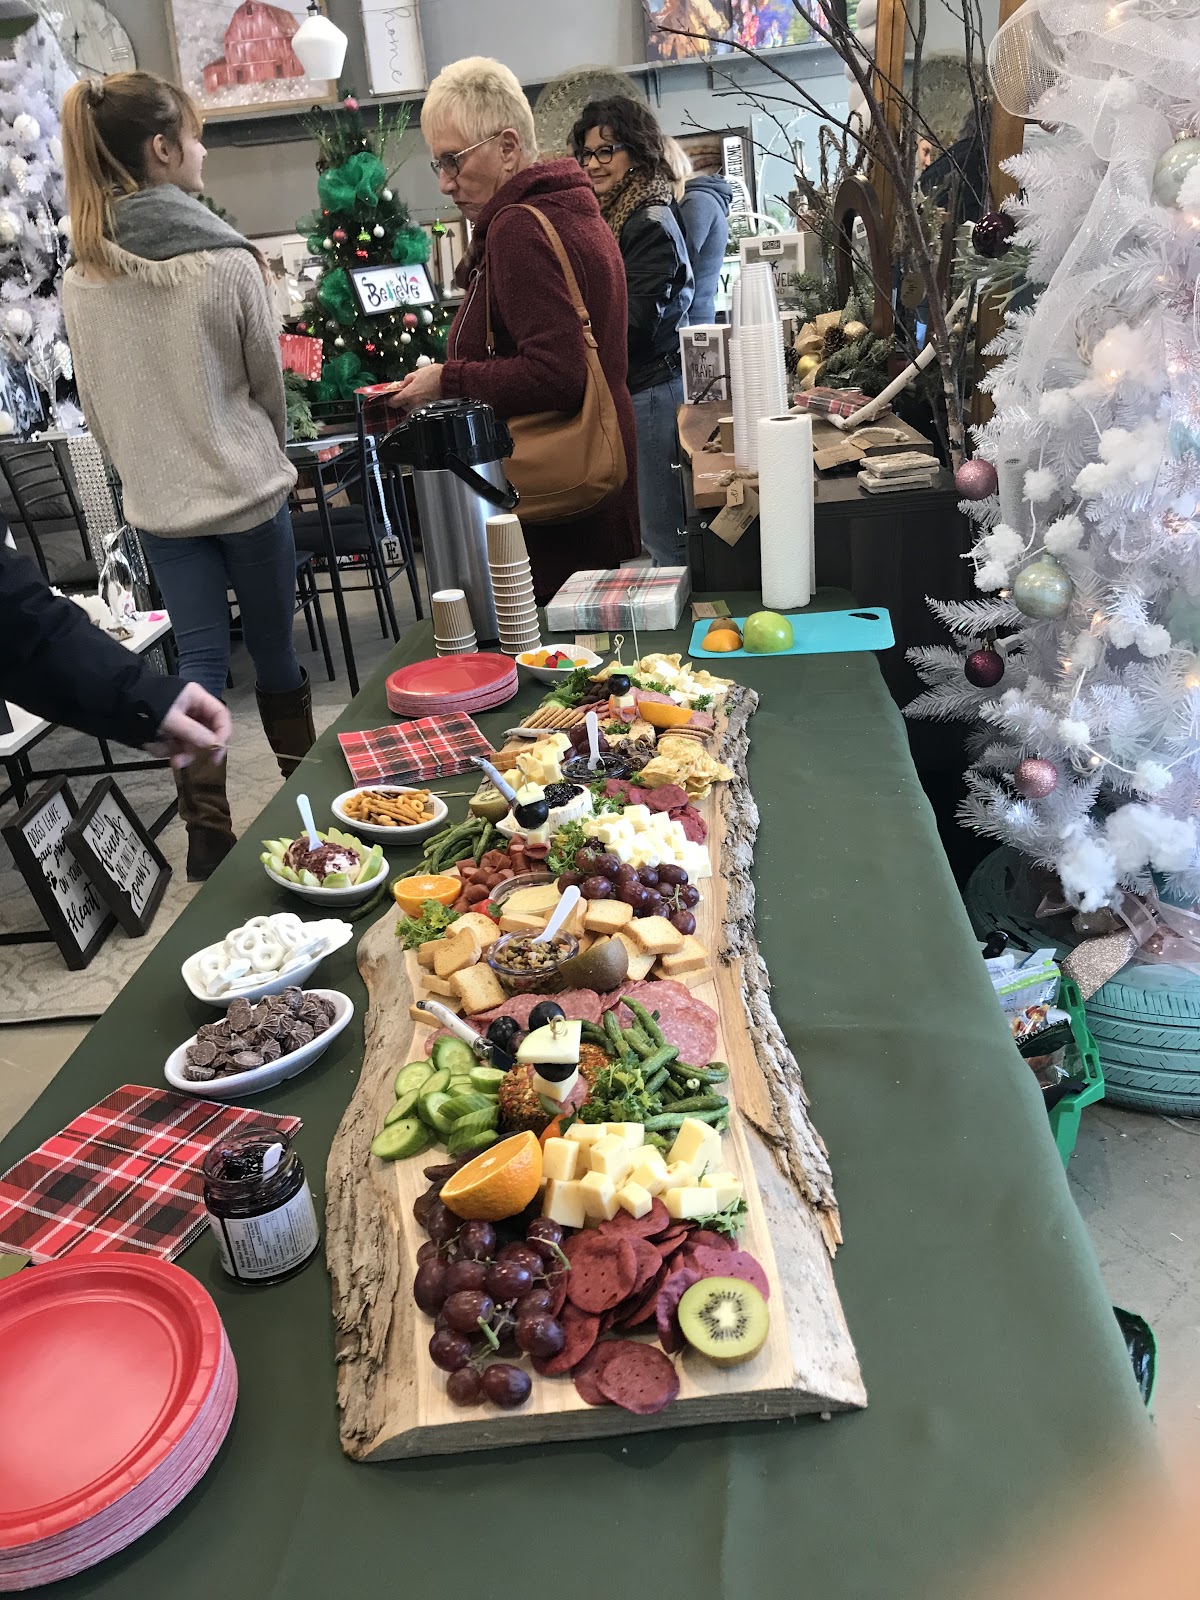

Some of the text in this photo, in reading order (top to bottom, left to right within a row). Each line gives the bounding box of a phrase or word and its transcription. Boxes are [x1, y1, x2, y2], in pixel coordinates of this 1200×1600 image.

[382, 7, 411, 84] home
[727, 144, 743, 166] HOME
[384, 541, 400, 561] E
[27, 803, 63, 849] DOGS LEAVE
[89, 811, 107, 841] BEST
[58, 877, 70, 895] ON
[66, 881, 101, 933] Heart
